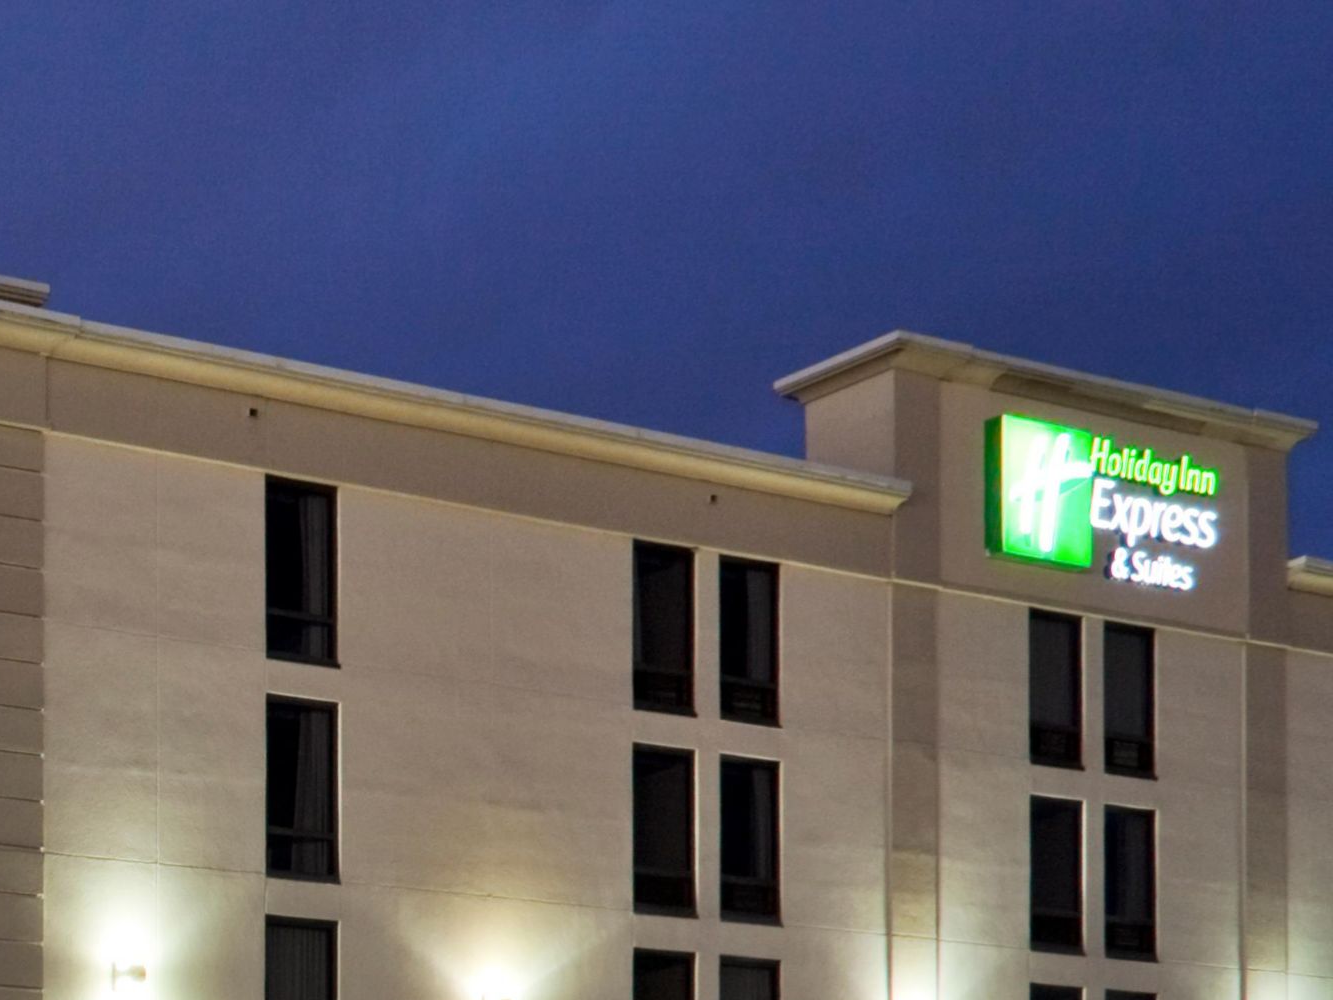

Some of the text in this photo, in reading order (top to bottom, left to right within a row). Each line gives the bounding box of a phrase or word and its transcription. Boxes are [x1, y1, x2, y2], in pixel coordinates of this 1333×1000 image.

[1090, 436, 1217, 496] Holiday Inn
[1089, 476, 1217, 549] Express
[1110, 546, 1194, 591] & Suites
